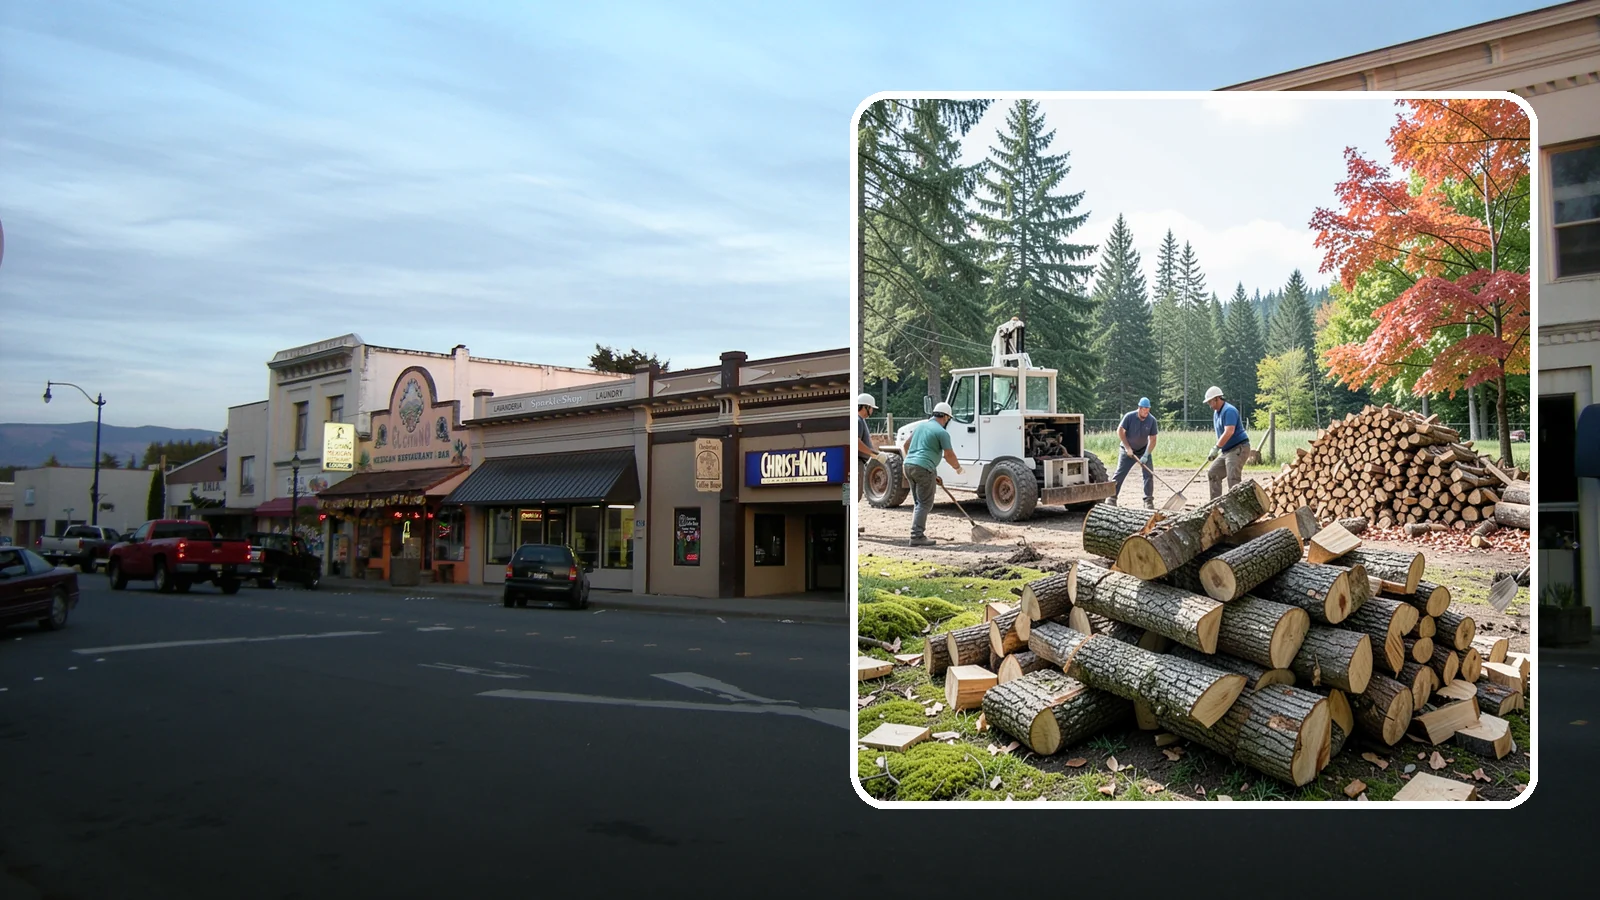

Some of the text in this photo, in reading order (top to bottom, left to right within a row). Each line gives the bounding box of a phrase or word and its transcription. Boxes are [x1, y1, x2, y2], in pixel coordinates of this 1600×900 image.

[596, 389, 623, 400] LAUNDRY
[493, 402, 523, 413] LAVANDERIA
[530, 394, 583, 409] Sparkle Shop
[373, 454, 396, 464] MEXICAN
[397, 451, 433, 462] RESTAURANT
[438, 450, 450, 459] BAR
[760, 449, 827, 478] CHRIST KING
[696, 480, 709, 489] Coffee
